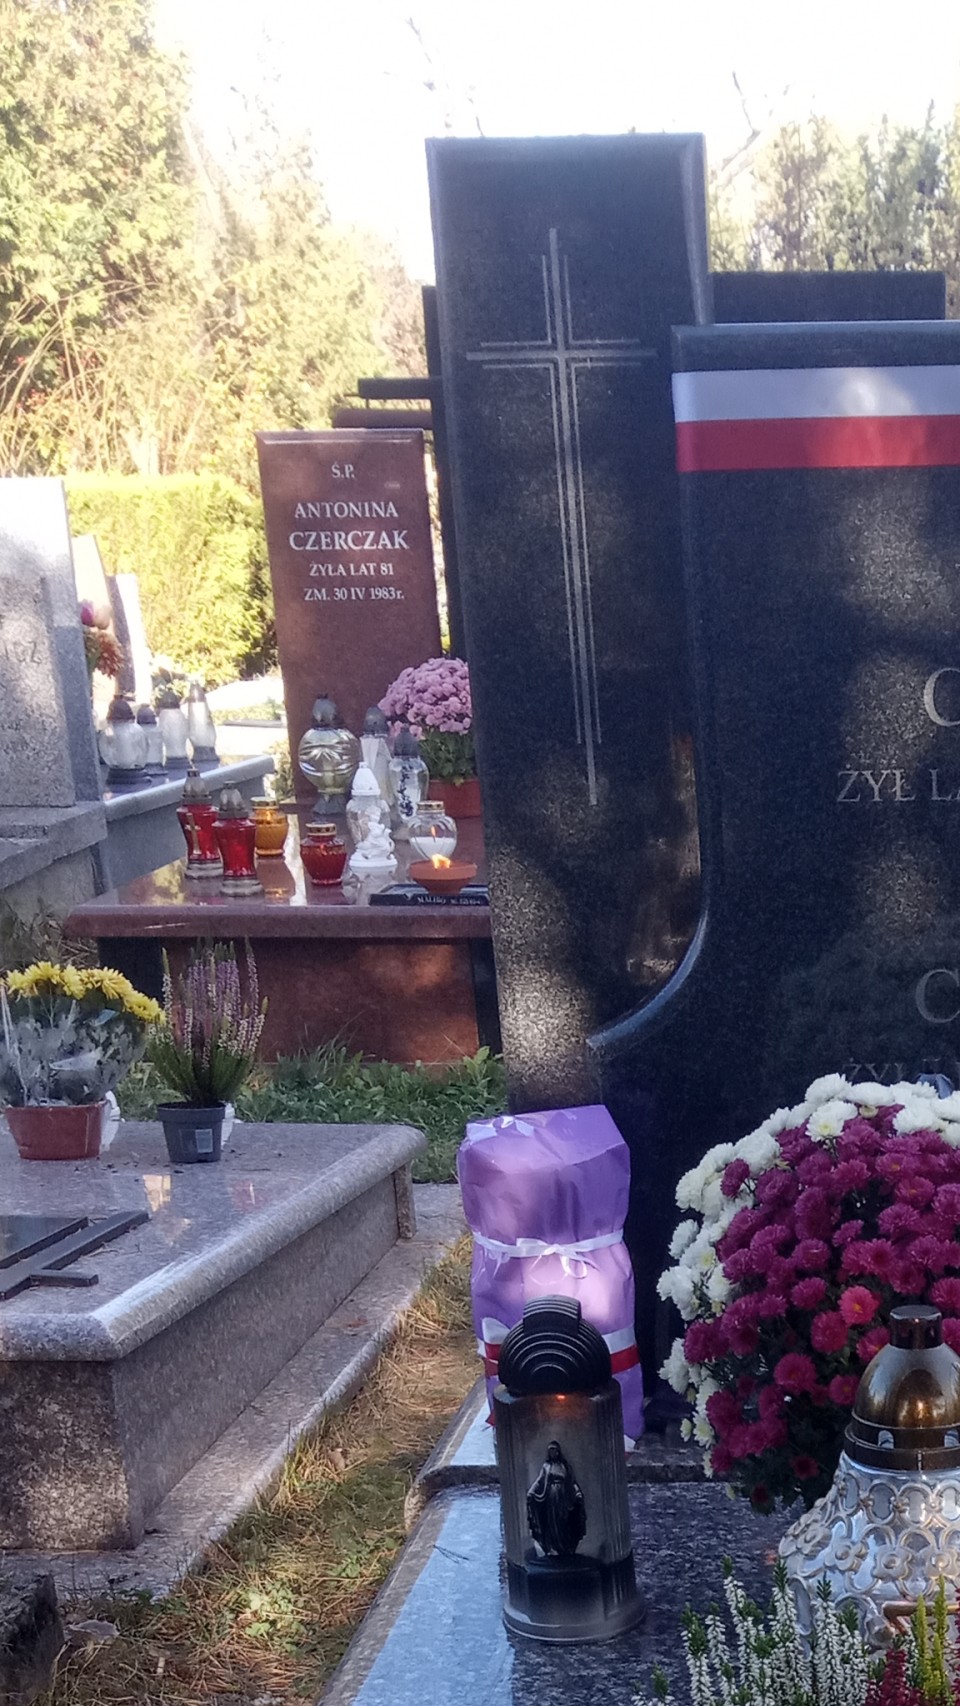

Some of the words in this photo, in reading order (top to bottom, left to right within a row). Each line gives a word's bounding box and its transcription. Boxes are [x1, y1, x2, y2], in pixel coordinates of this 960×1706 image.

[294, 501, 399, 519] ANTONINA
[289, 530, 410, 551] CZERCZAK
[309, 561, 347, 576] ŻYŁA
[349, 562, 377, 576] LAT
[380, 562, 395, 576] 81
[303, 587, 331, 601] ZM.
[333, 587, 348, 601] 30
[350, 587, 366, 600] IV
[837, 763, 917, 802] ŻYŁ
